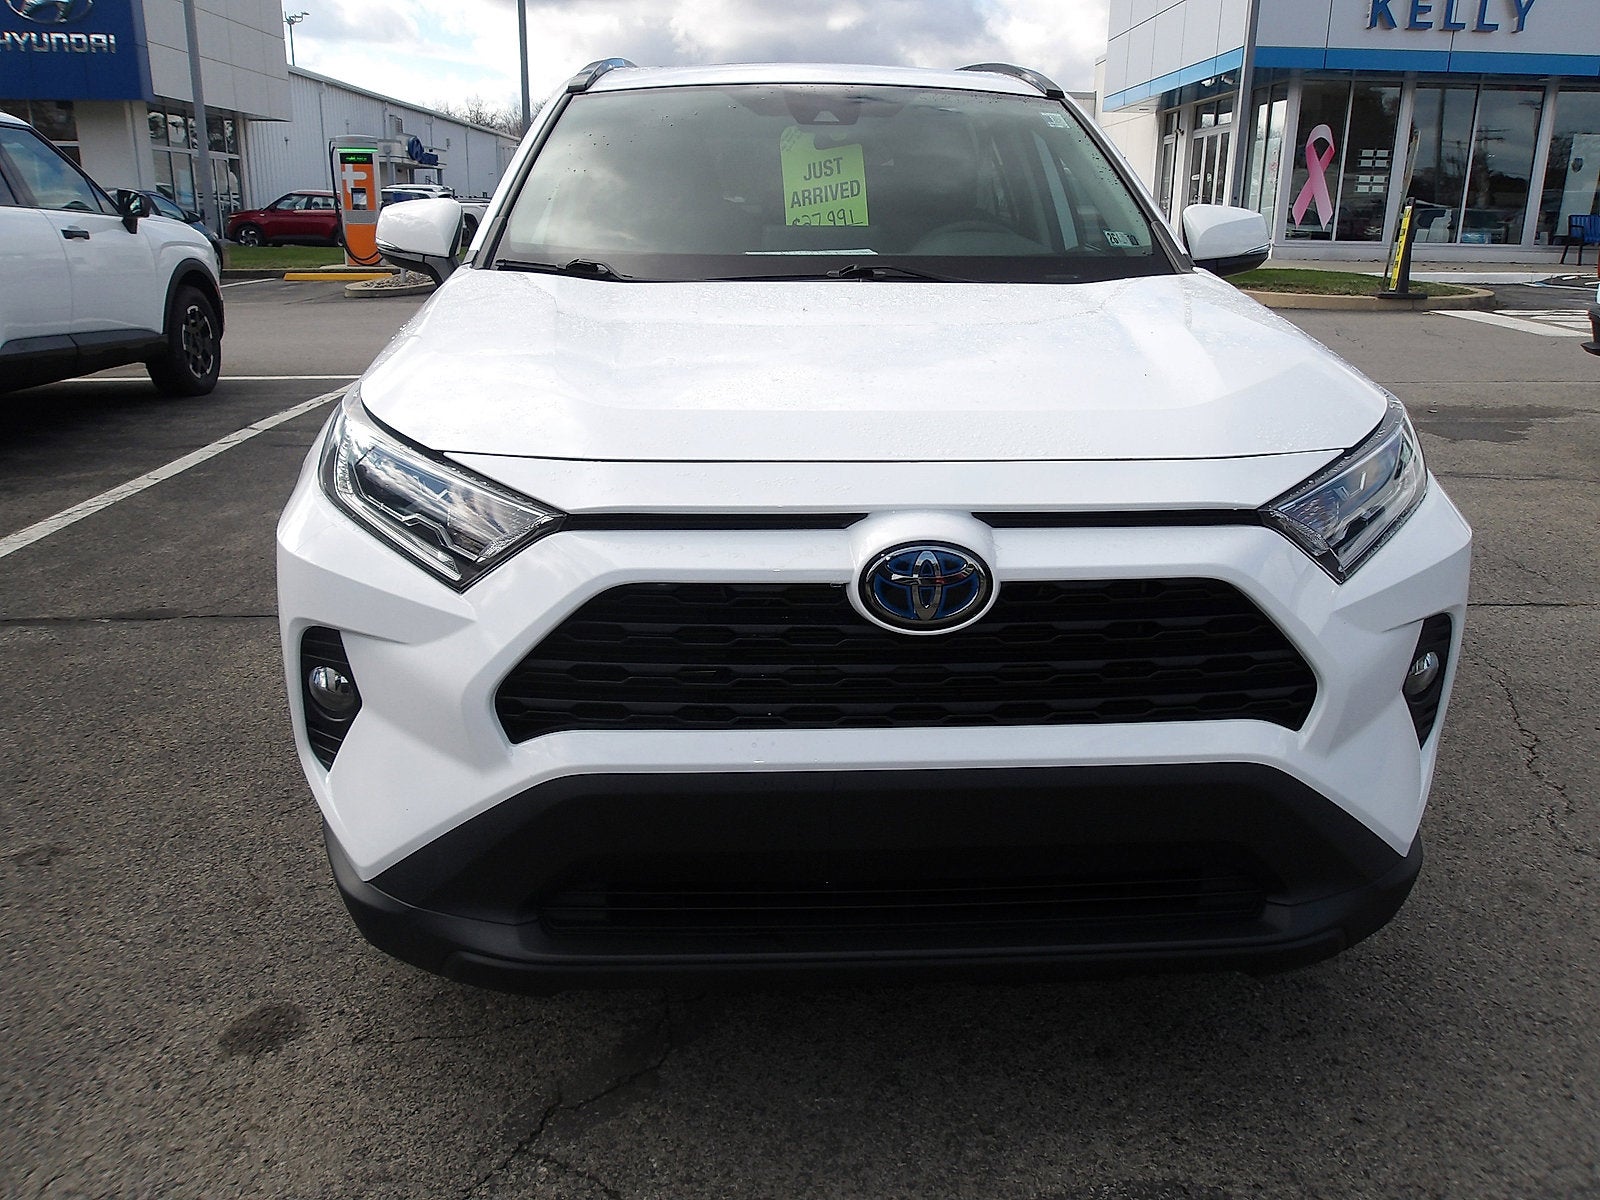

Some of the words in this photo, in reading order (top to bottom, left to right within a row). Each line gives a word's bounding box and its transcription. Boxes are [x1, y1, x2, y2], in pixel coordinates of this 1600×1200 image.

[1365, 0, 1535, 34] KELLY
[803, 156, 843, 181] JUST
[790, 179, 861, 209] ARRIVED
